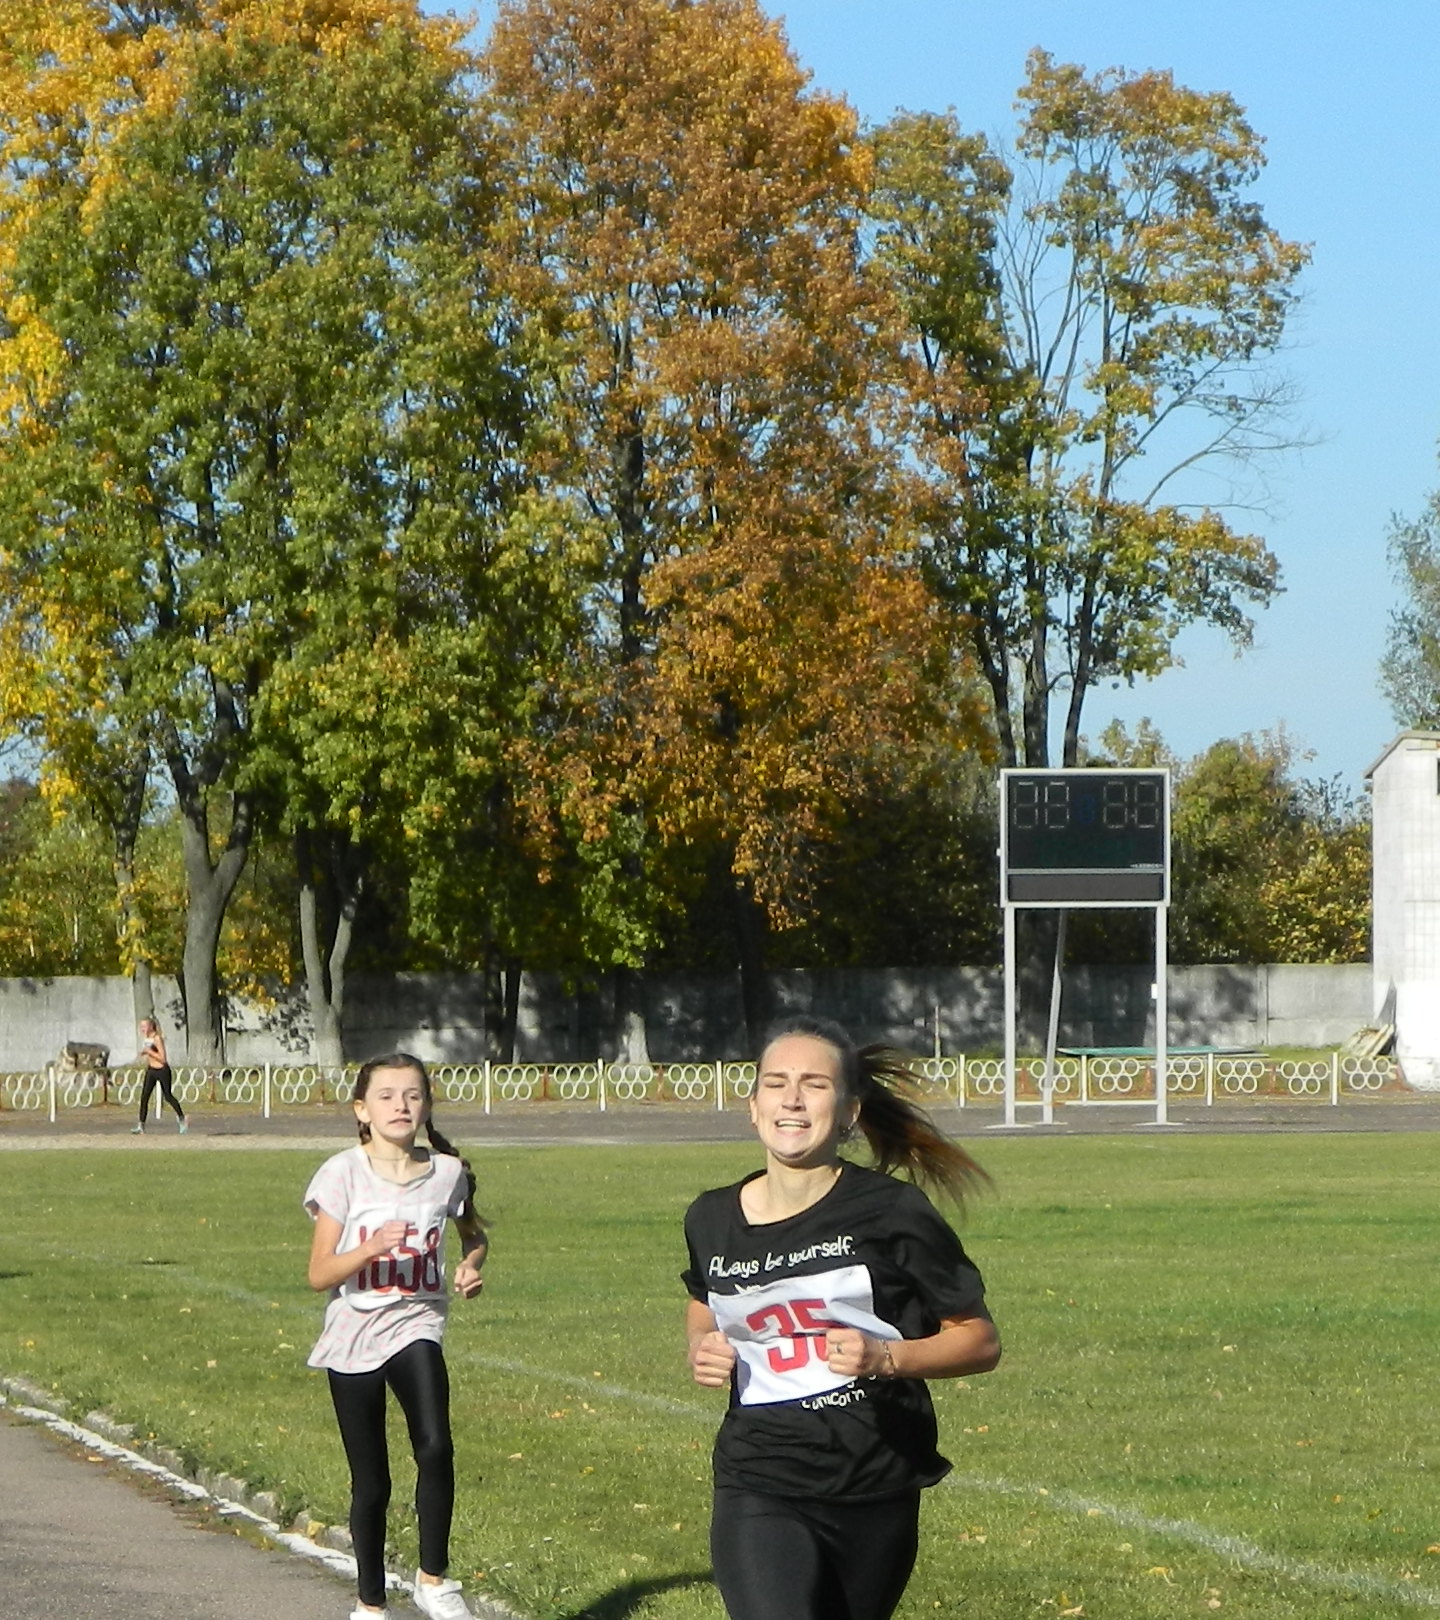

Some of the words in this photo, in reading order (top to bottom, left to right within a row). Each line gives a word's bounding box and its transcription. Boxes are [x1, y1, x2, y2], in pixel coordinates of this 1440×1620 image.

[708, 1255, 760, 1279] Always
[764, 1252, 784, 1272] be
[787, 1235, 857, 1267] yourself.
[746, 1298, 849, 1374] 35
